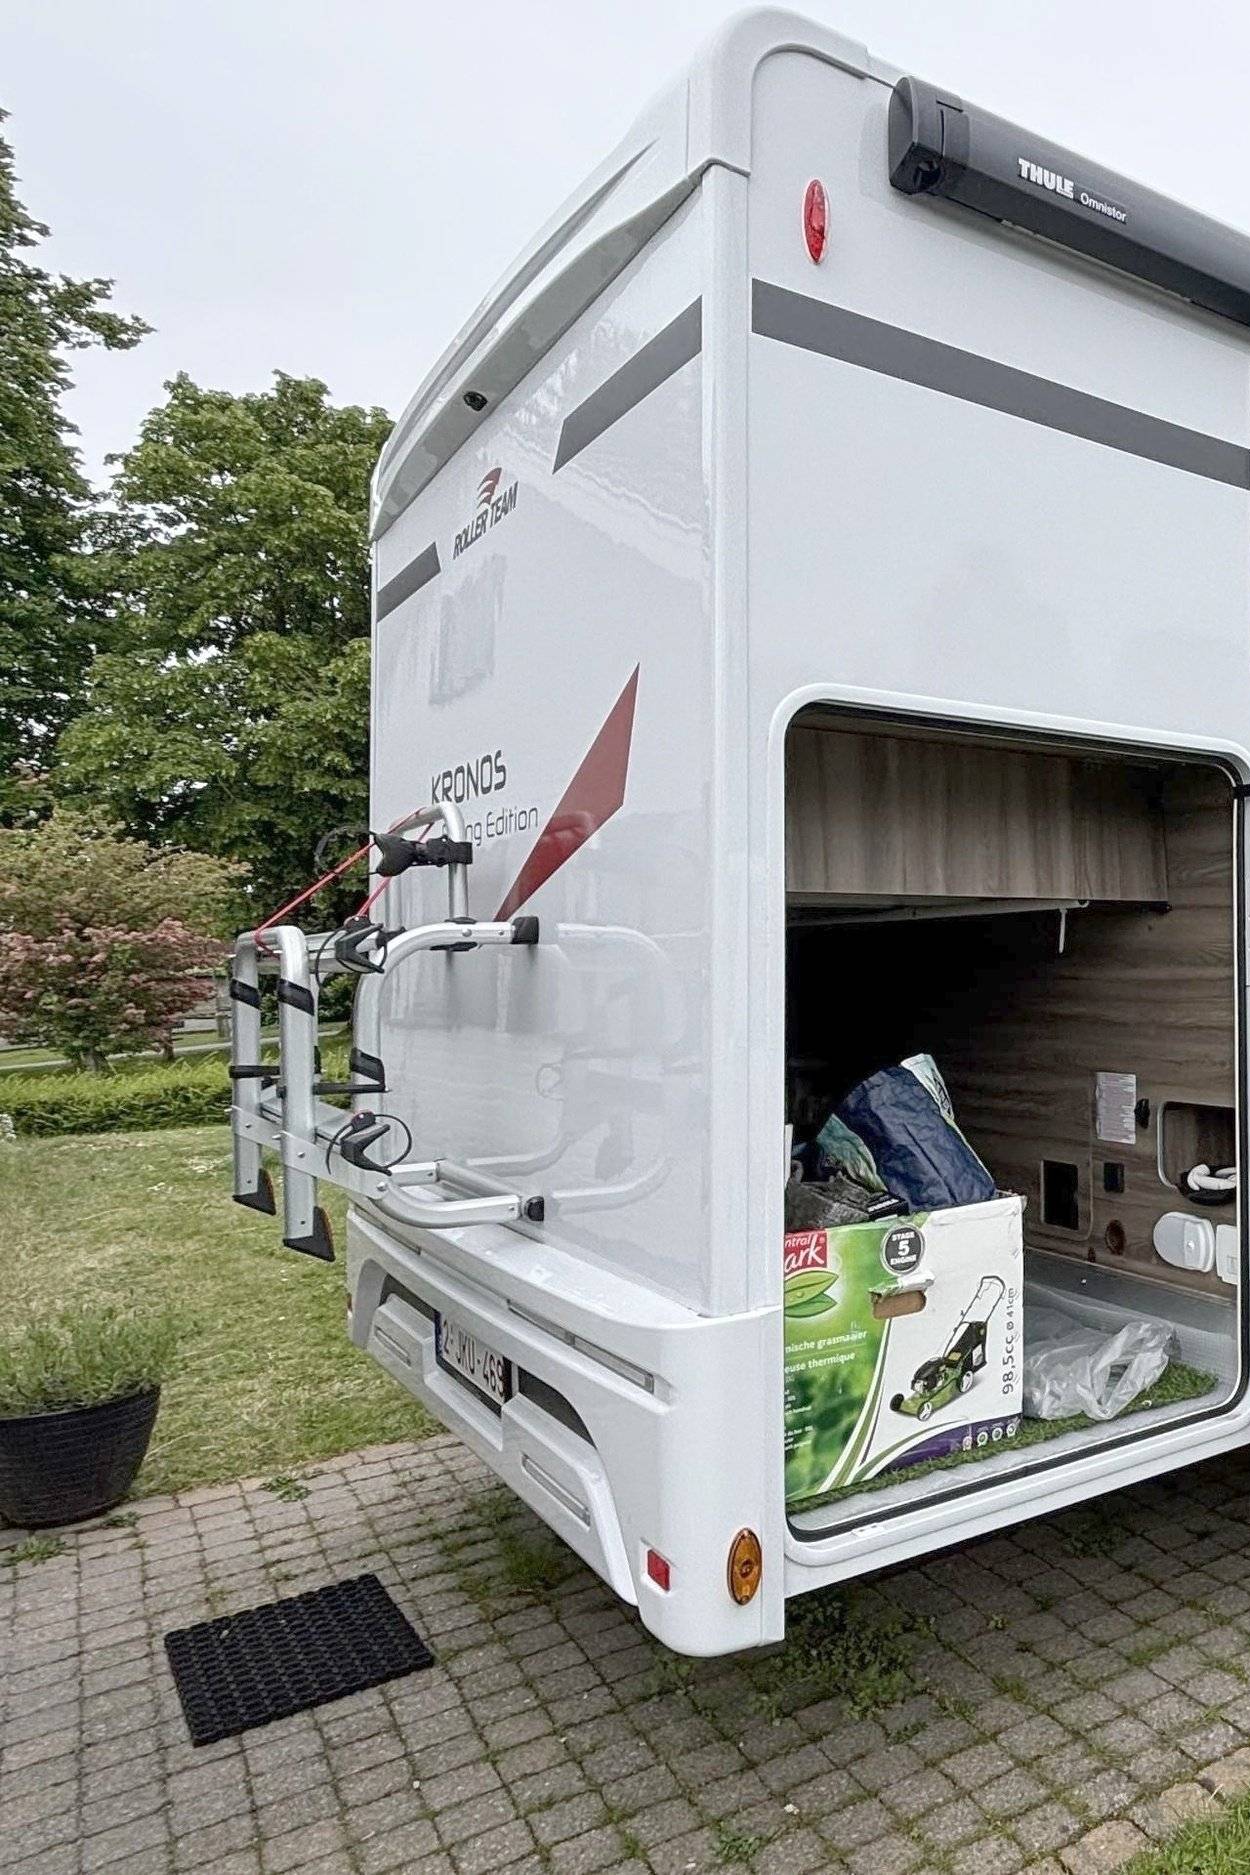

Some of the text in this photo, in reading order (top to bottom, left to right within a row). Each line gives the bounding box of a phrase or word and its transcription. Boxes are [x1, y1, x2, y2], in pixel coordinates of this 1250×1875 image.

[1018, 157, 1127, 223] THULE Omnistor
[453, 481, 519, 560] ROLLER TEAM
[431, 749, 507, 804] KRONOS
[486, 806, 539, 839] Edition
[785, 1233, 812, 1248] ntral
[785, 1233, 825, 1273] ark
[892, 1231, 915, 1241] STAGE
[898, 1240, 910, 1256] 5
[785, 1353, 855, 1374] euse thermique
[1002, 1335, 1015, 1395] 98,5cc
